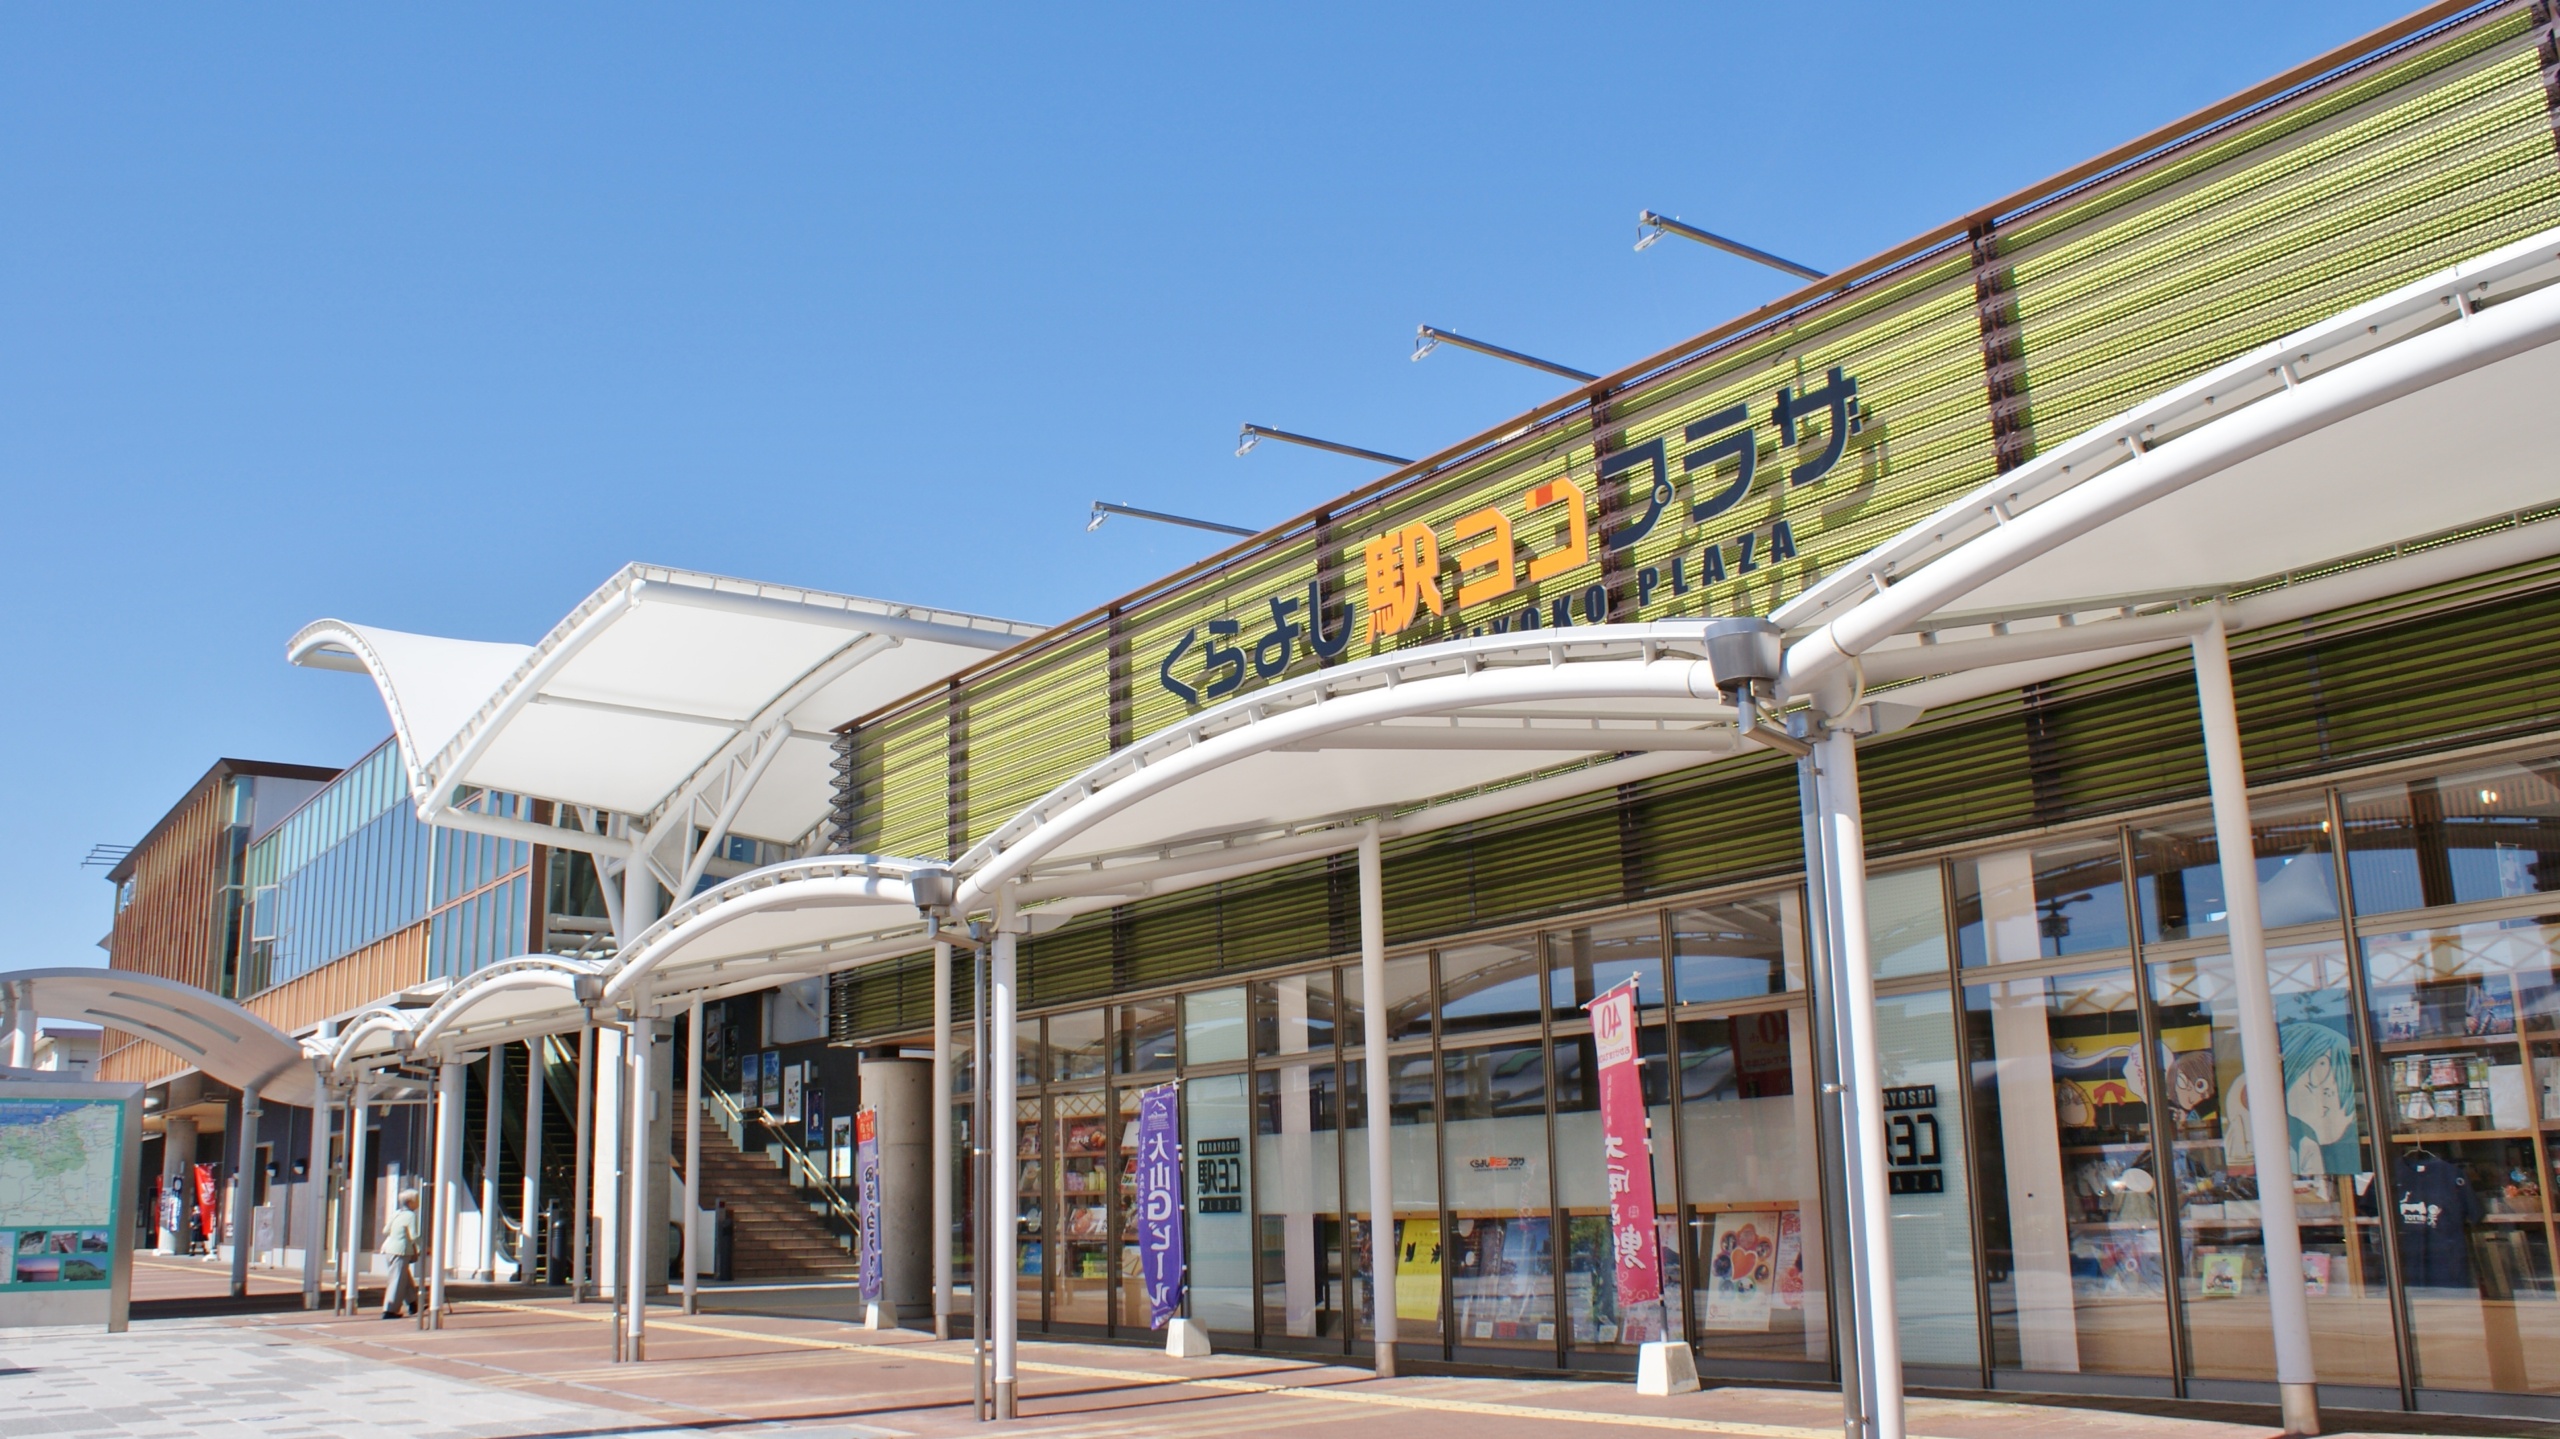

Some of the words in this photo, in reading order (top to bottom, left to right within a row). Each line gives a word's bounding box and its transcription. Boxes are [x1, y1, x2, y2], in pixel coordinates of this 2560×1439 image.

[1638, 520, 1798, 607] PLAZA
[1882, 1088, 1933, 1106] AYOSHI
[1200, 1141, 1239, 1154] KURAYOSHI
[1884, 1114, 1942, 1166] ヨコ
[1197, 1158, 1241, 1195] 駅ヨコ
[1895, 1174, 1940, 1191] AZA
[1200, 1199, 1240, 1212] PLAZA
